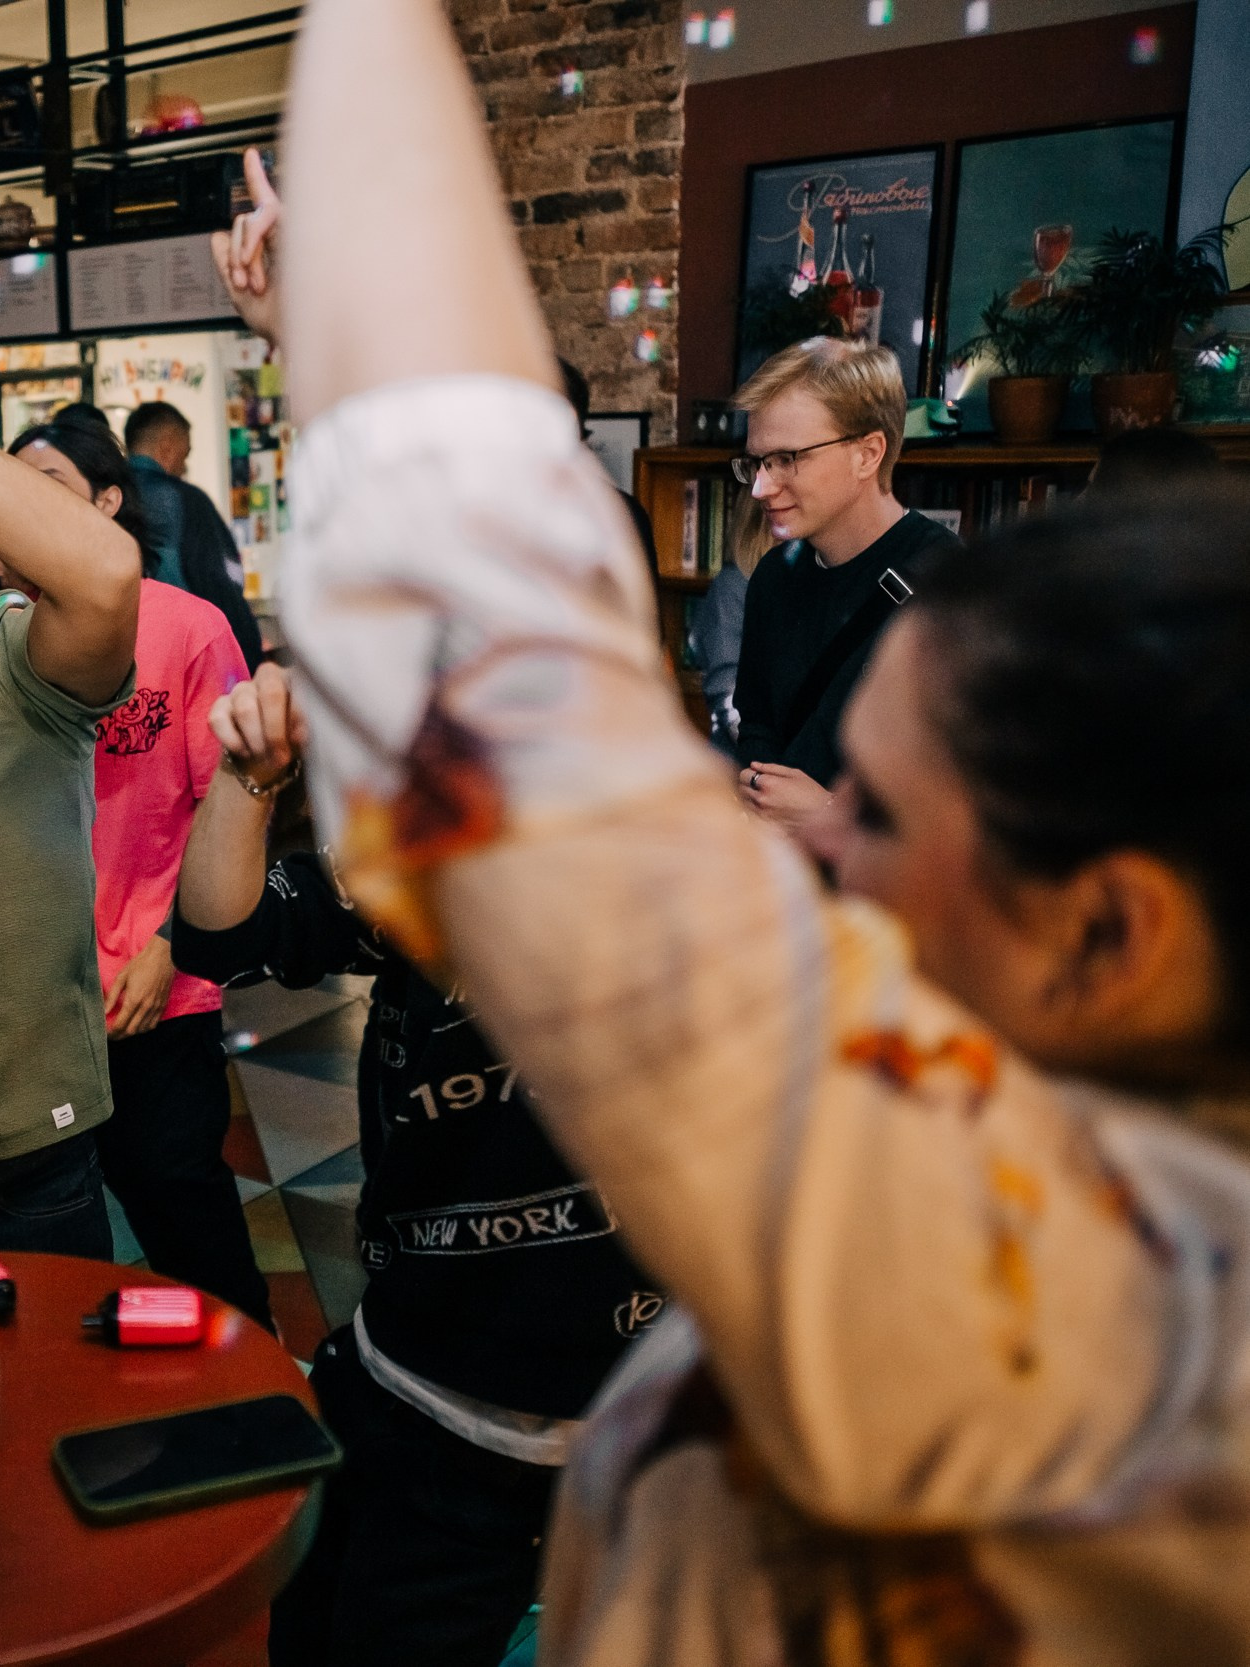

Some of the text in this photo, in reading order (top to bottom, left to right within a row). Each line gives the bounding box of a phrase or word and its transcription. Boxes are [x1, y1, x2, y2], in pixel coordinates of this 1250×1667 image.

[409, 1058, 524, 1121] 197
[411, 1198, 580, 1249] NEW YORK
